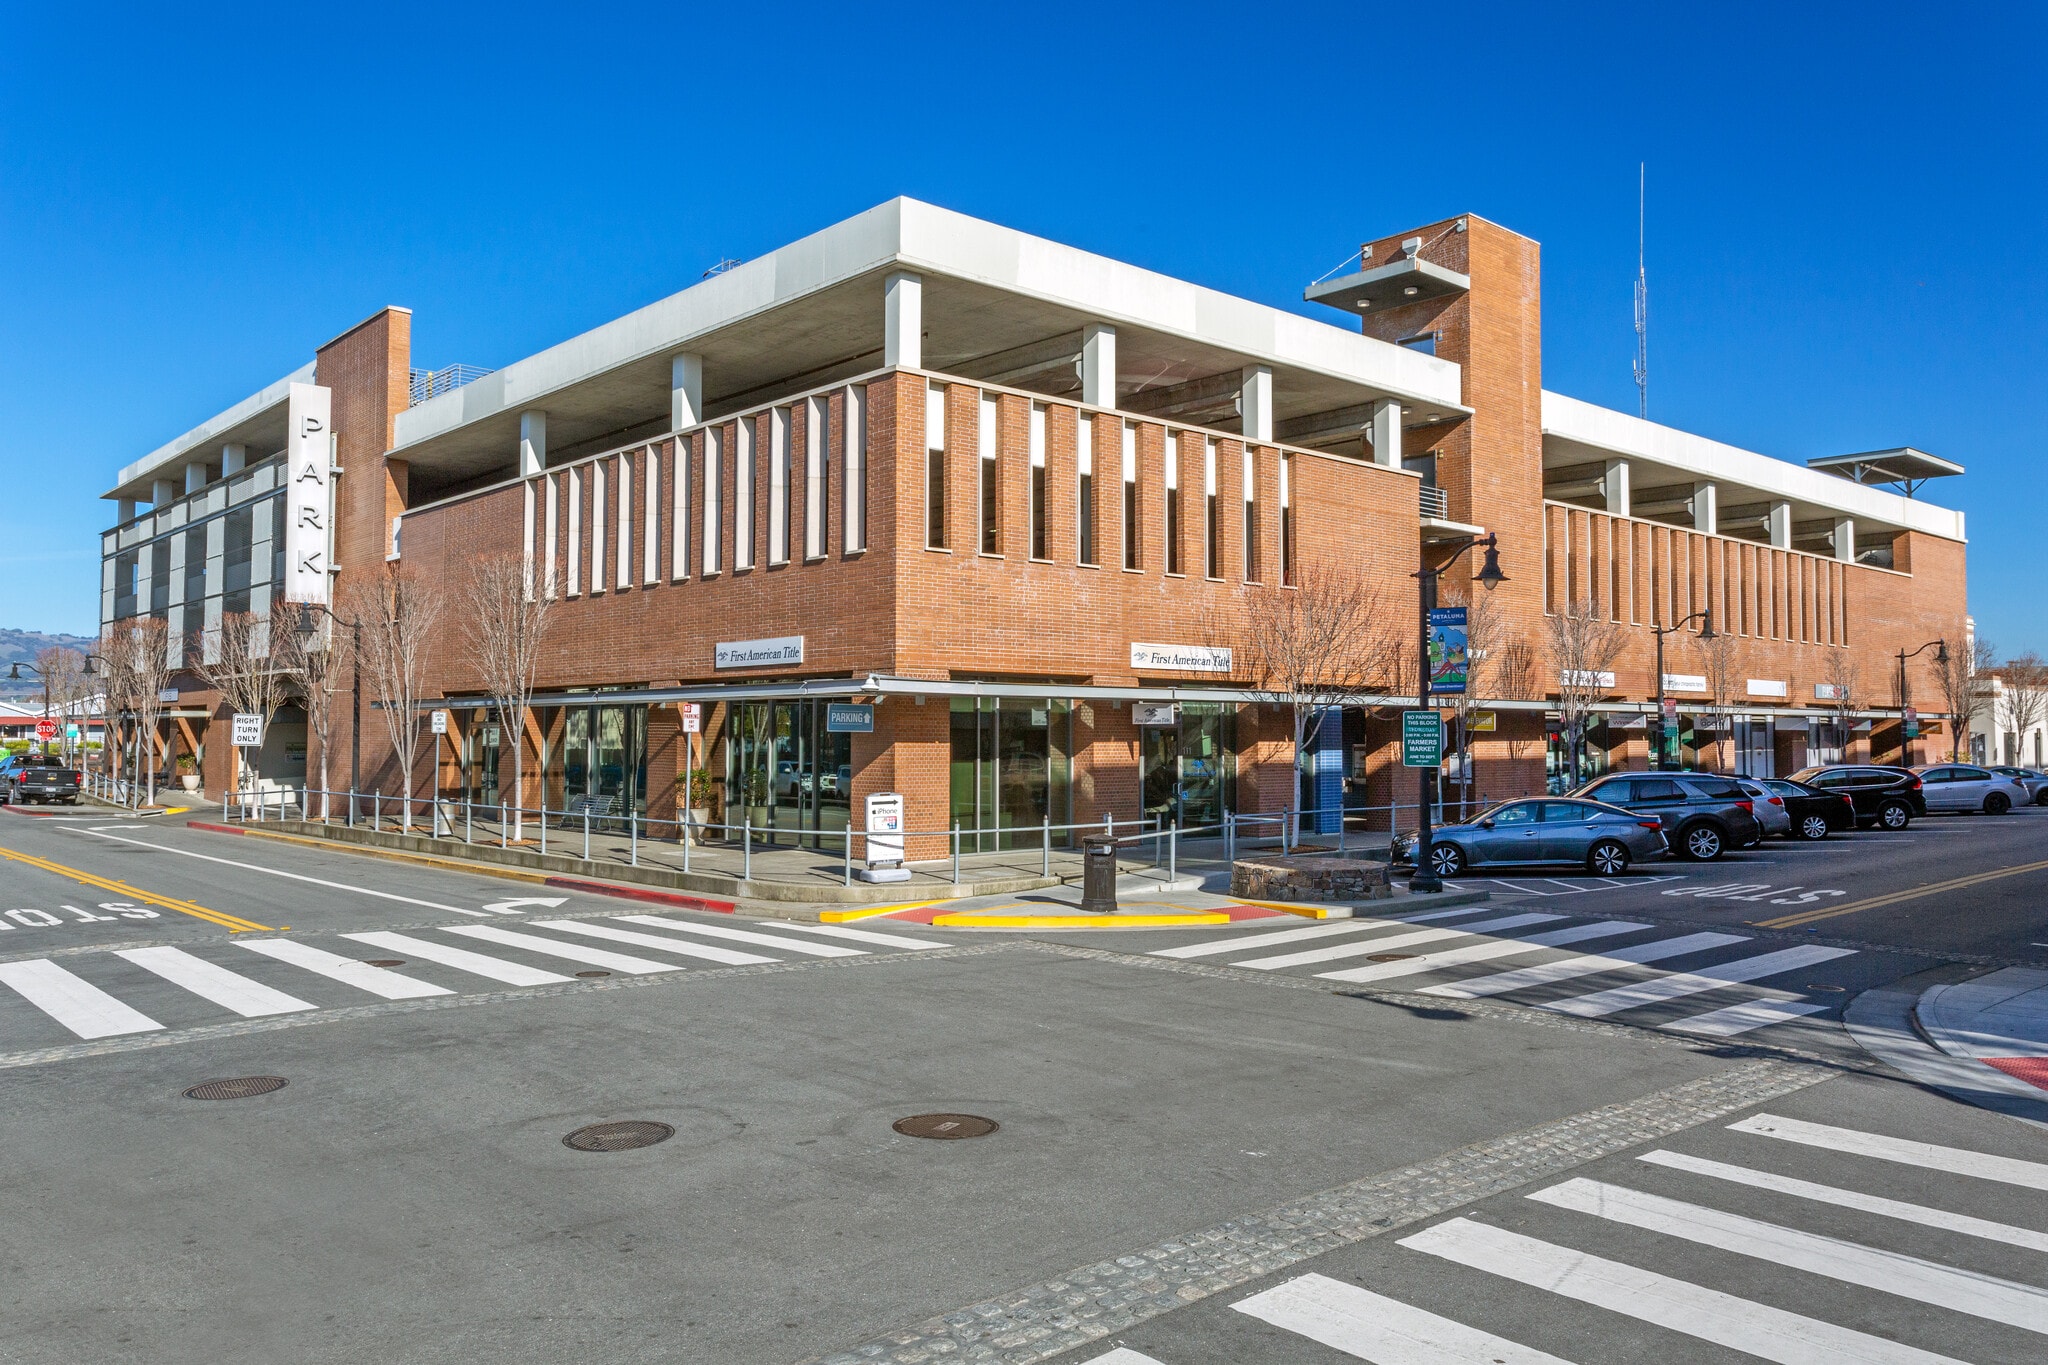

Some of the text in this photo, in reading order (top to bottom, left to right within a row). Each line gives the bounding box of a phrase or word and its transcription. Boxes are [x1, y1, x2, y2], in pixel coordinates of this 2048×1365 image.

[296, 415, 323, 575] PARK
[730, 646, 800, 662] First American Title
[1150, 652, 1230, 667] First American Title
[831, 712, 863, 723] PARKING
[37, 725, 56, 733] STOP
[877, 807, 898, 815] iPhone
[1661, 883, 1847, 905] STOP
[0, 902, 161, 931] STO
